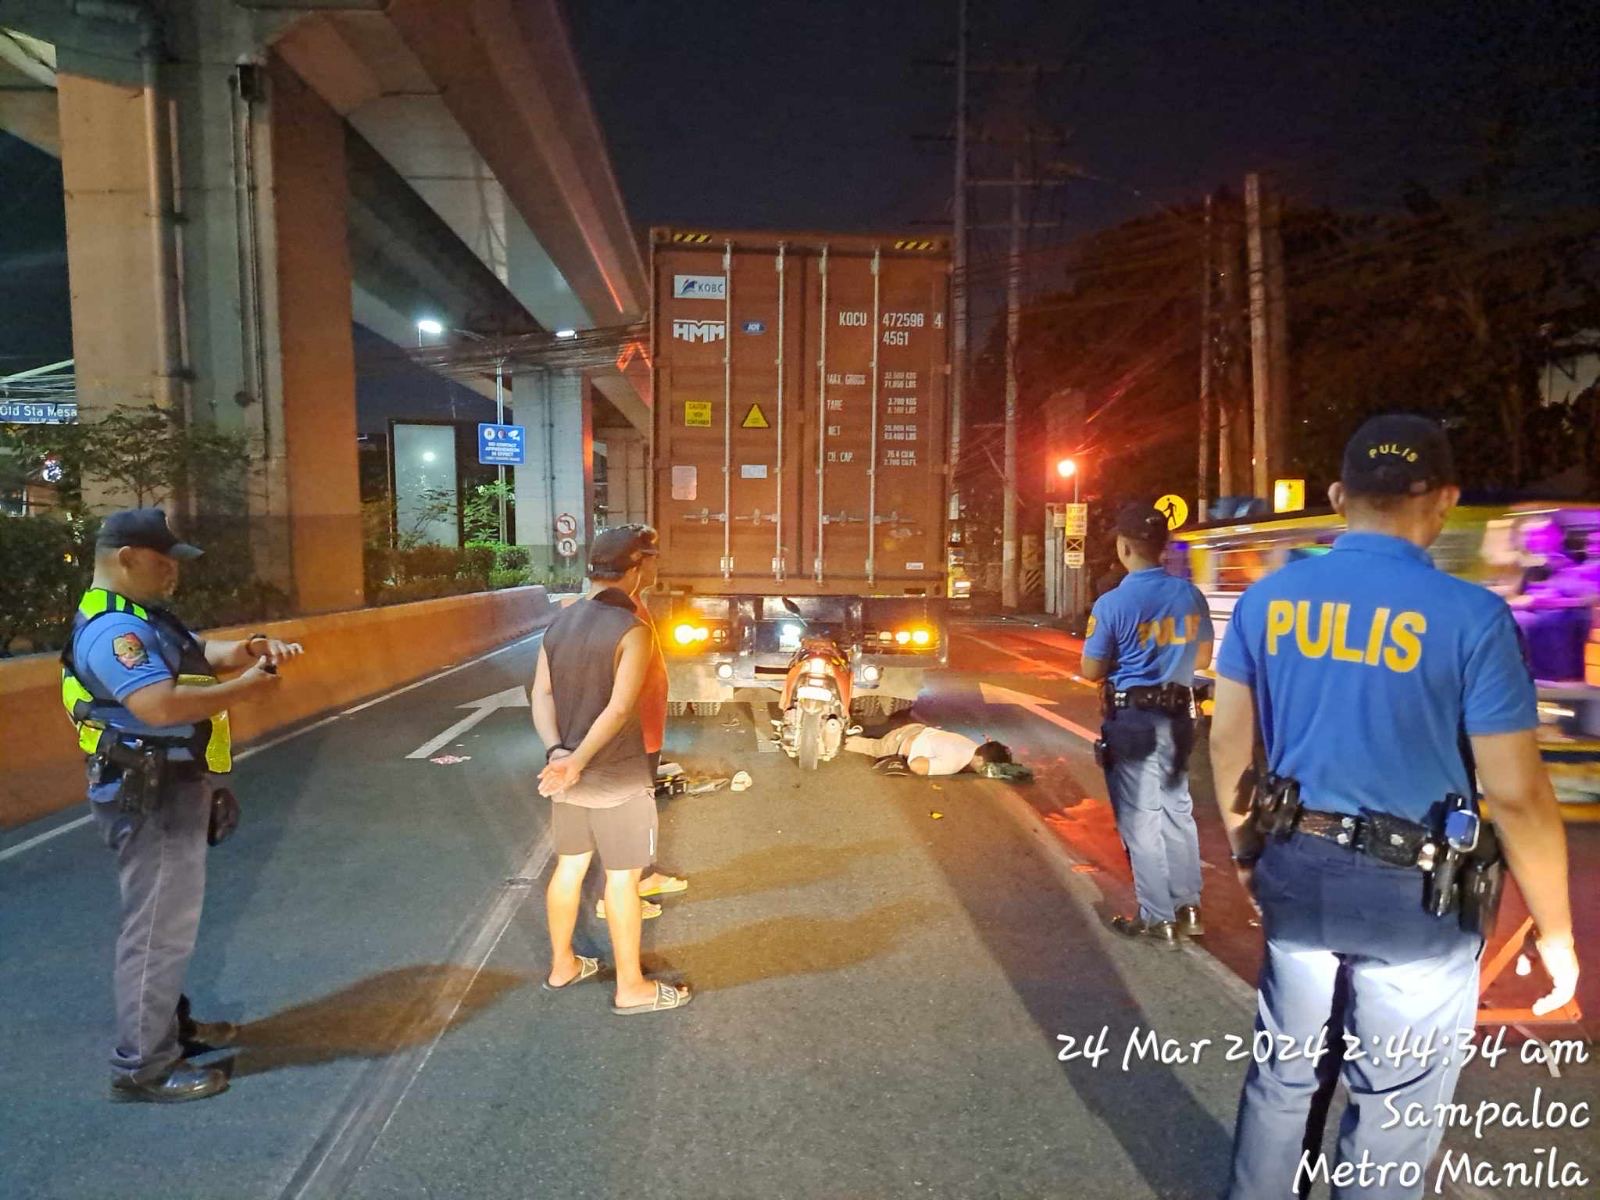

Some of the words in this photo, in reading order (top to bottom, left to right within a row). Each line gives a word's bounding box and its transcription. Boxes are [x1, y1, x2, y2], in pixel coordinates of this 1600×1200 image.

[699, 283, 723, 293] KOBC
[839, 312, 867, 326] KOCU
[882, 313, 924, 328] 472596
[934, 313, 943, 328] 4
[673, 319, 725, 343] HMM
[882, 331, 908, 345] 45G1
[0, 405, 20, 416] Old
[23, 405, 43, 416] Sta
[47, 406, 77, 416] Mesa
[1369, 444, 1418, 462] PULIS
[1266, 599, 1427, 673] PULIS
